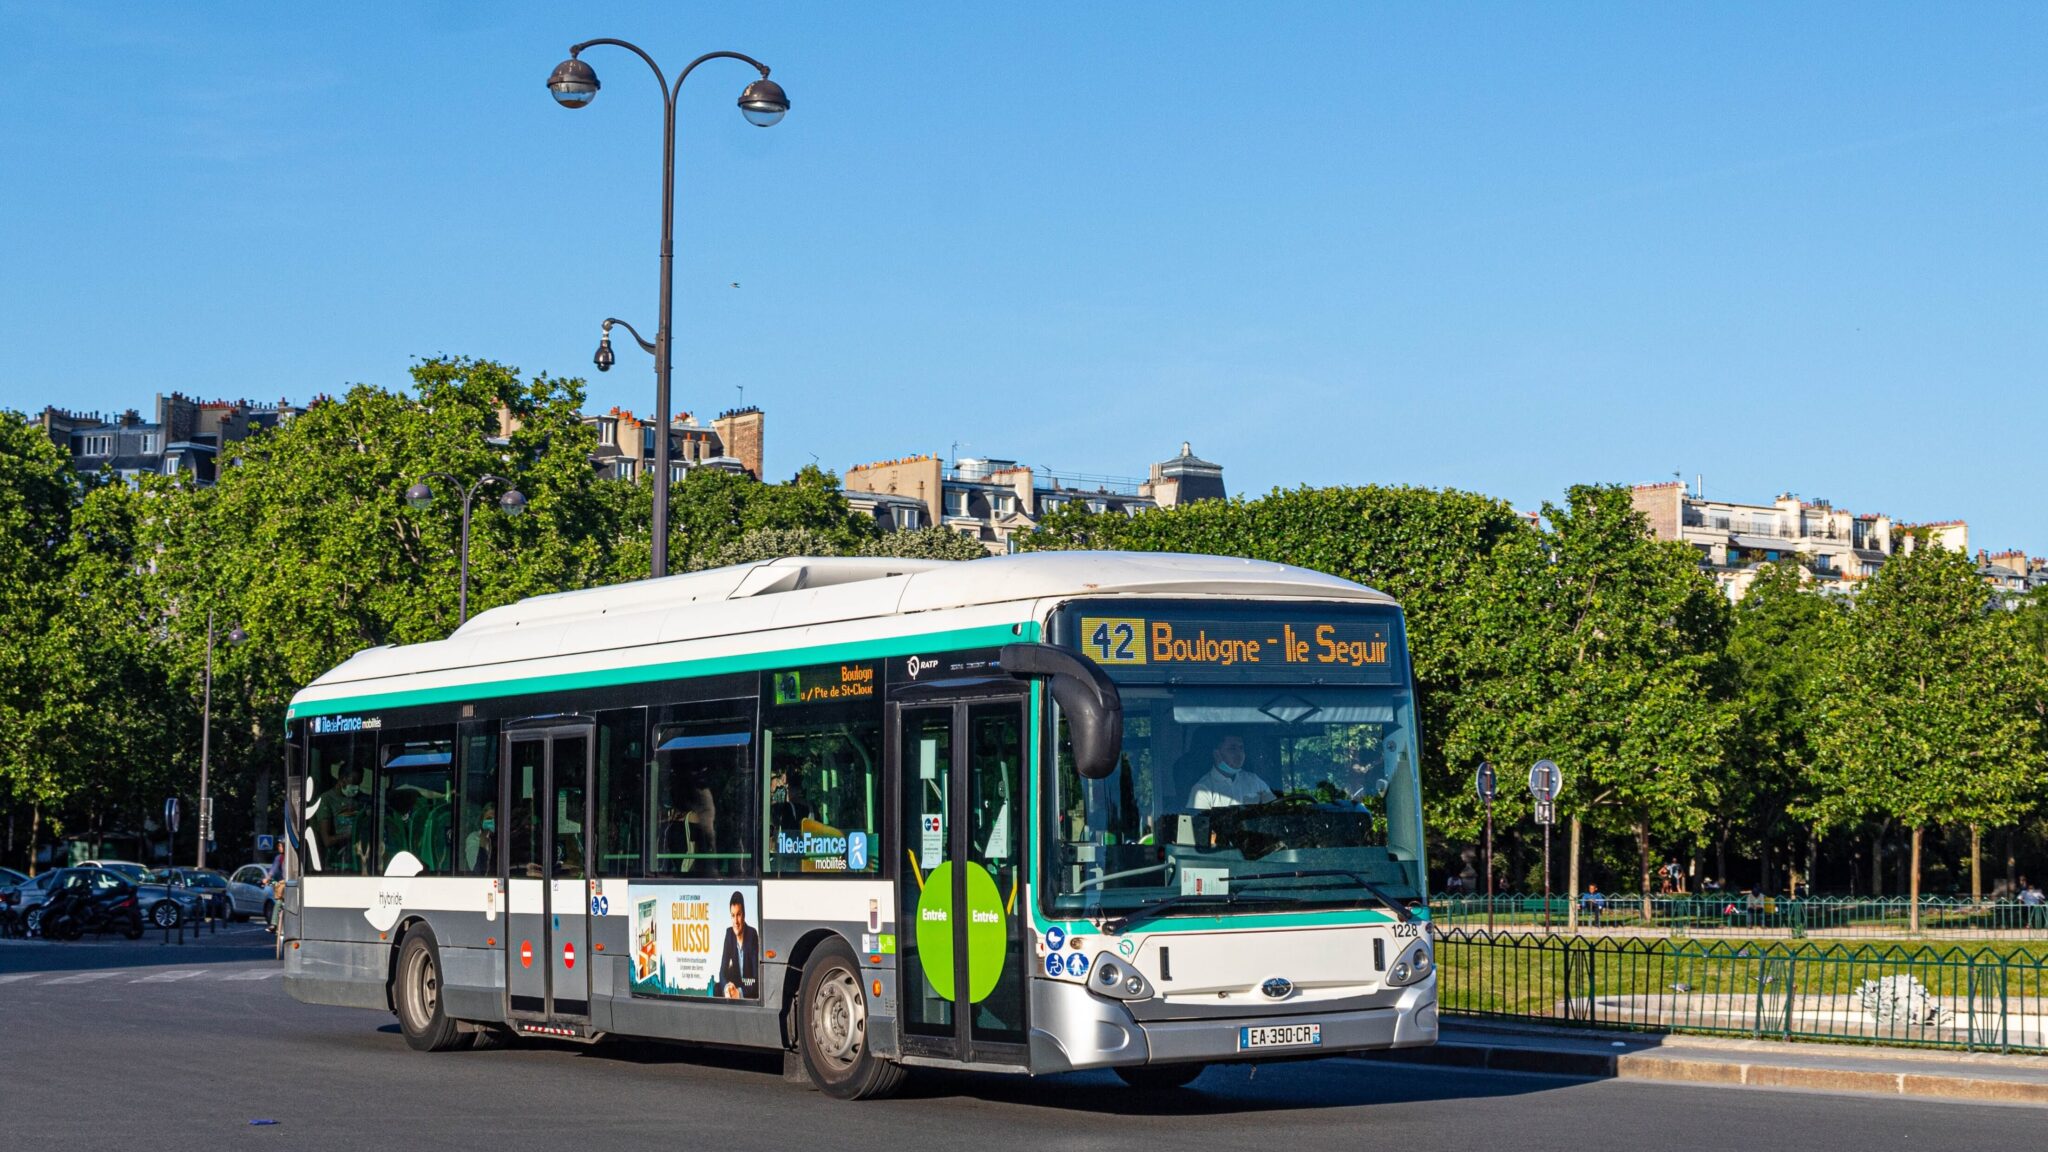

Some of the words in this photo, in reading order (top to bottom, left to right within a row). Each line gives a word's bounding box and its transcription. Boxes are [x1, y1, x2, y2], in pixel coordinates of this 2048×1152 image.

[1092, 622, 1135, 659] 42
[1152, 622, 1260, 665] Boulogne
[920, 660, 938, 669] RATP
[815, 686, 828, 698] Pte
[830, 685, 840, 697] de
[815, 856, 847, 870] mobilités
[379, 891, 402, 908] Hybride
[672, 902, 709, 920] GUILLAUME
[922, 908, 947, 921] Entrée
[972, 909, 999, 923] Entrée
[672, 923, 710, 953] MUSSO
[1391, 923, 1418, 938] 1228
[1251, 1026, 1311, 1045] EA-390-CR
